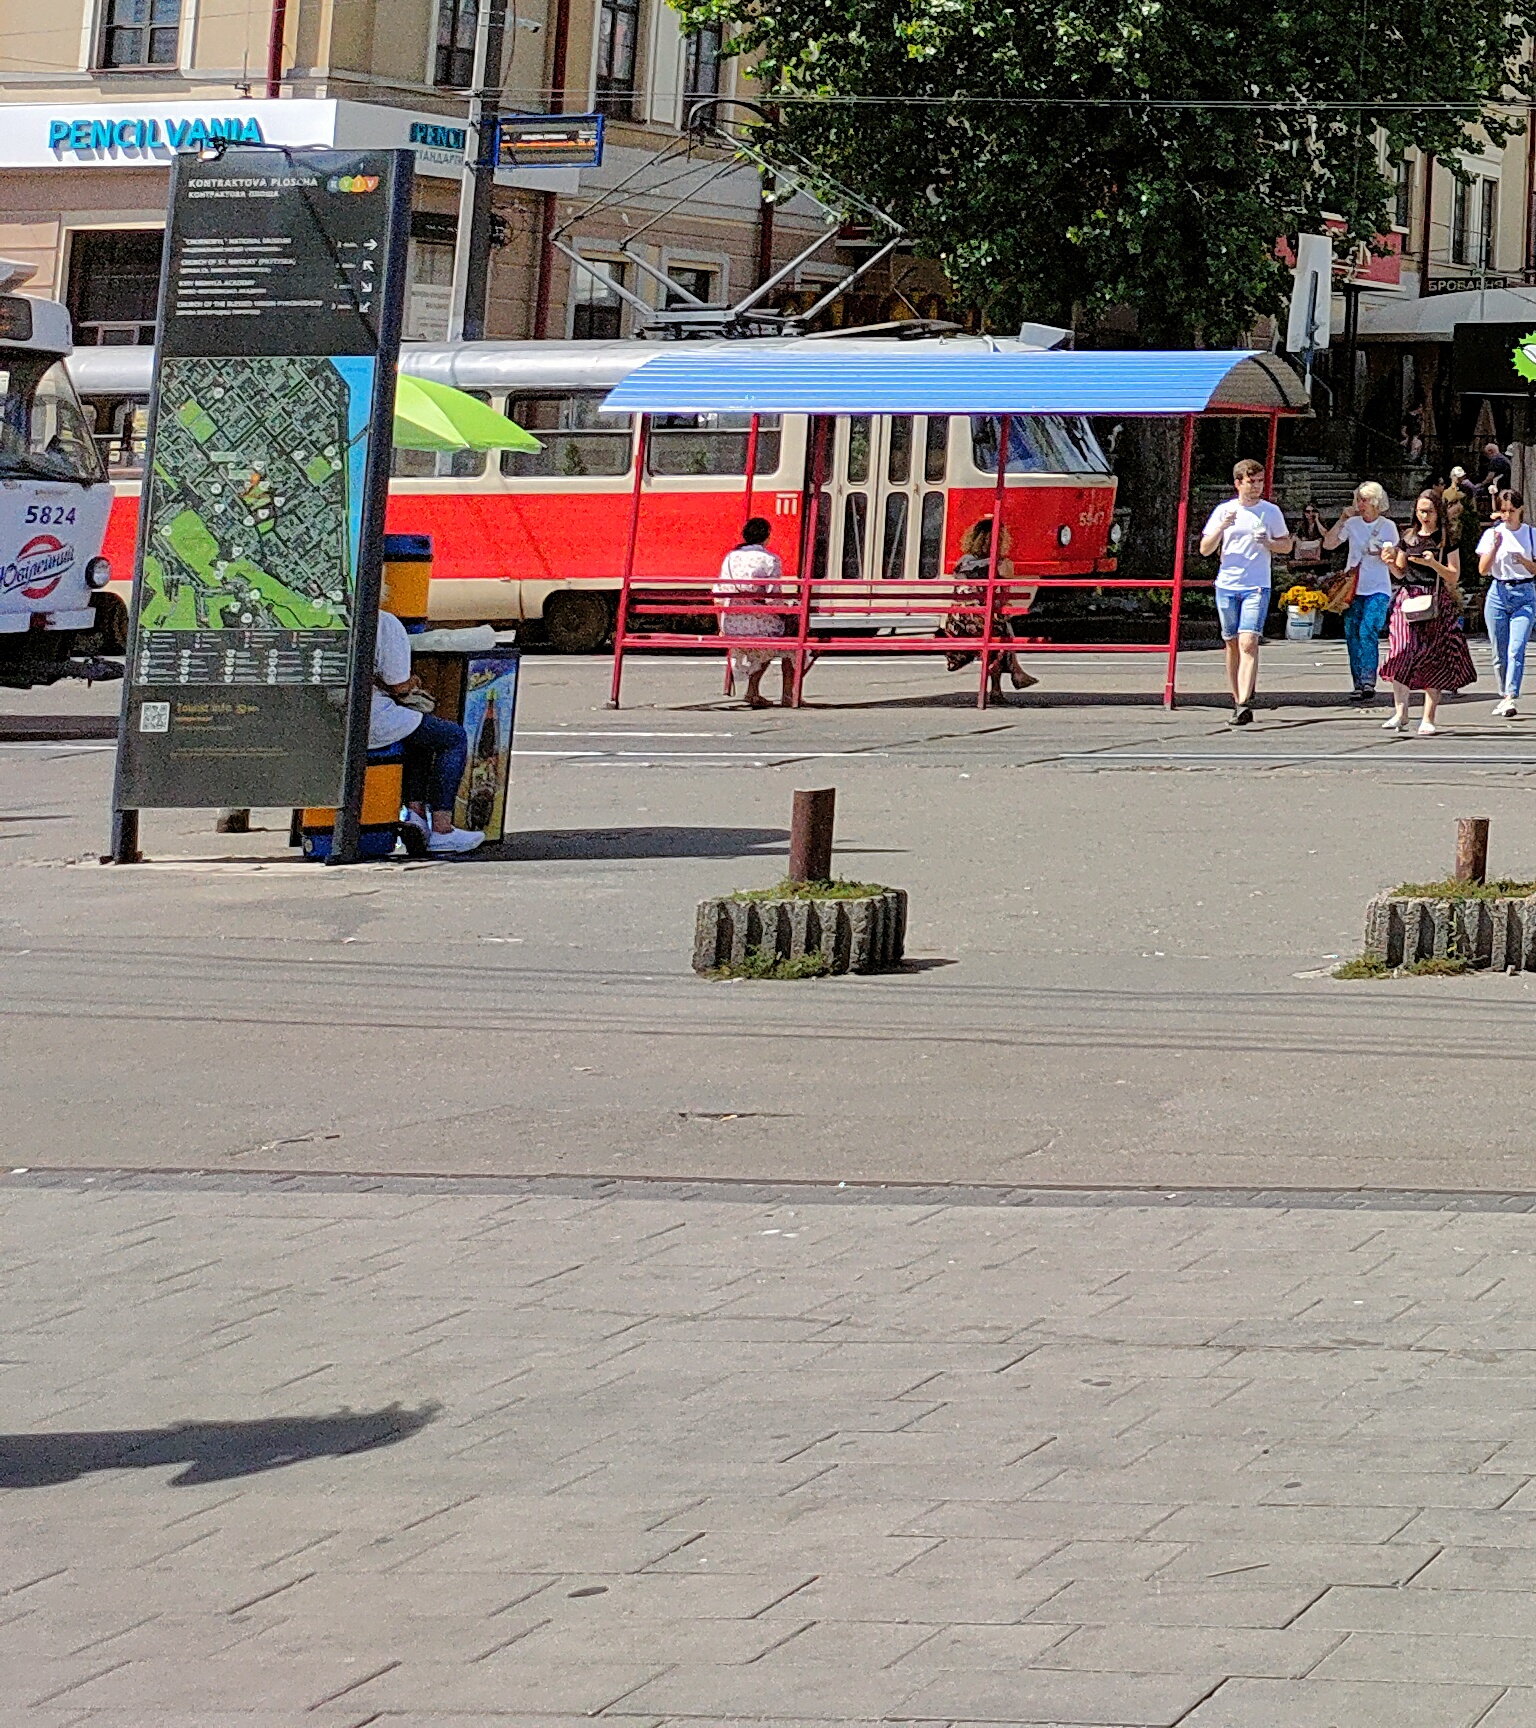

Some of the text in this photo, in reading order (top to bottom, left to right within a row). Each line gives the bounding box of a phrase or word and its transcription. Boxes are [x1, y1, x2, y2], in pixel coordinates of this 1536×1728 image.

[48, 118, 262, 149] PENCILVANIA
[188, 177, 318, 189] KONTRAKTOVA PLOSCHA
[25, 505, 77, 525] 5824
